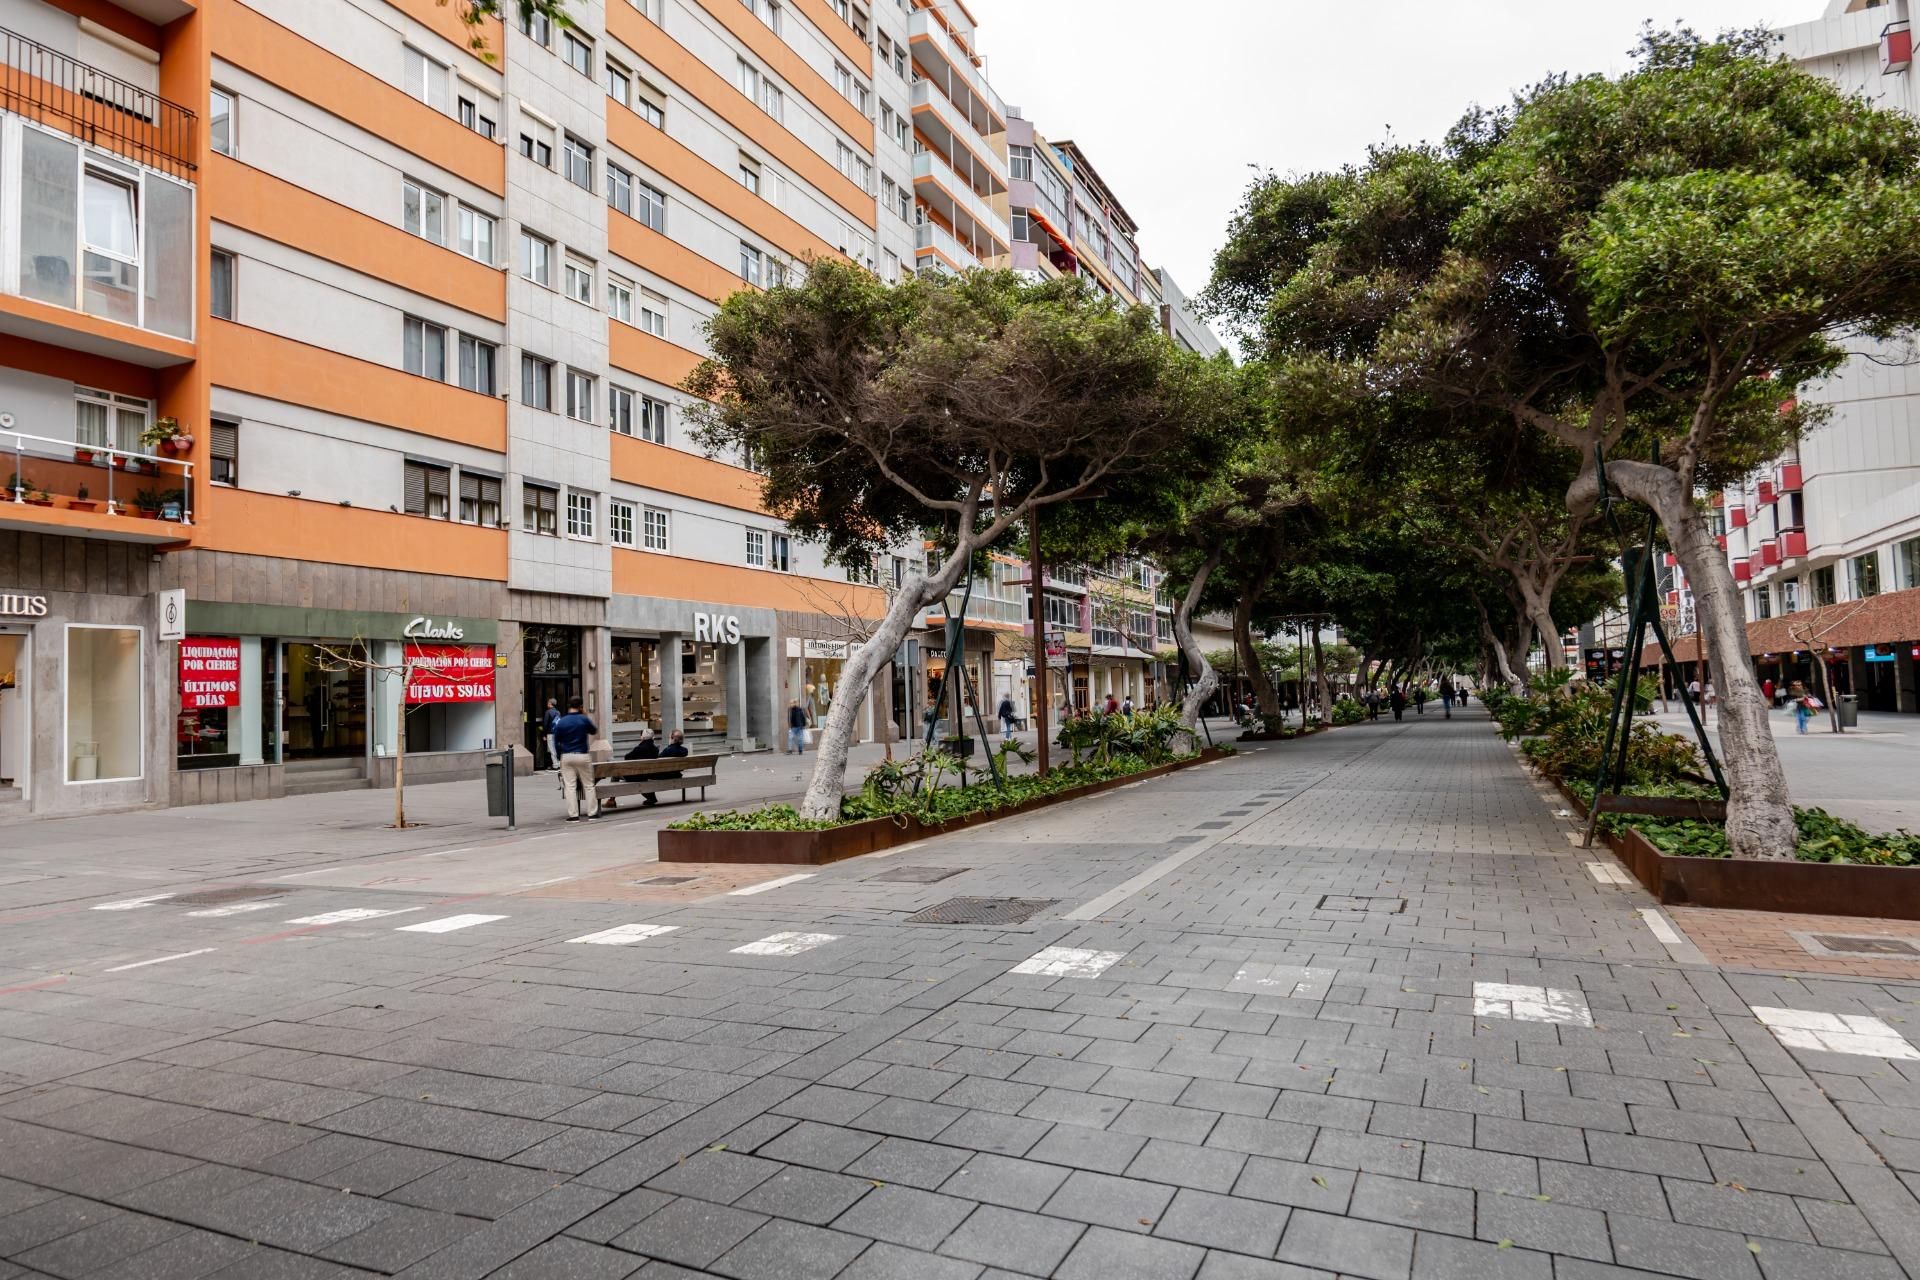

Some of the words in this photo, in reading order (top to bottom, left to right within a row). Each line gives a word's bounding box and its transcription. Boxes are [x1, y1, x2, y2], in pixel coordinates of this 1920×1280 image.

[404, 617, 464, 640] Clarks
[694, 612, 740, 645] RKS
[182, 645, 238, 659] LIQUIDACIÓN
[183, 659, 204, 671] POR
[205, 659, 238, 671] CIERRE
[184, 680, 237, 693] ÚLTIMOS
[195, 692, 226, 706] DÍAS
